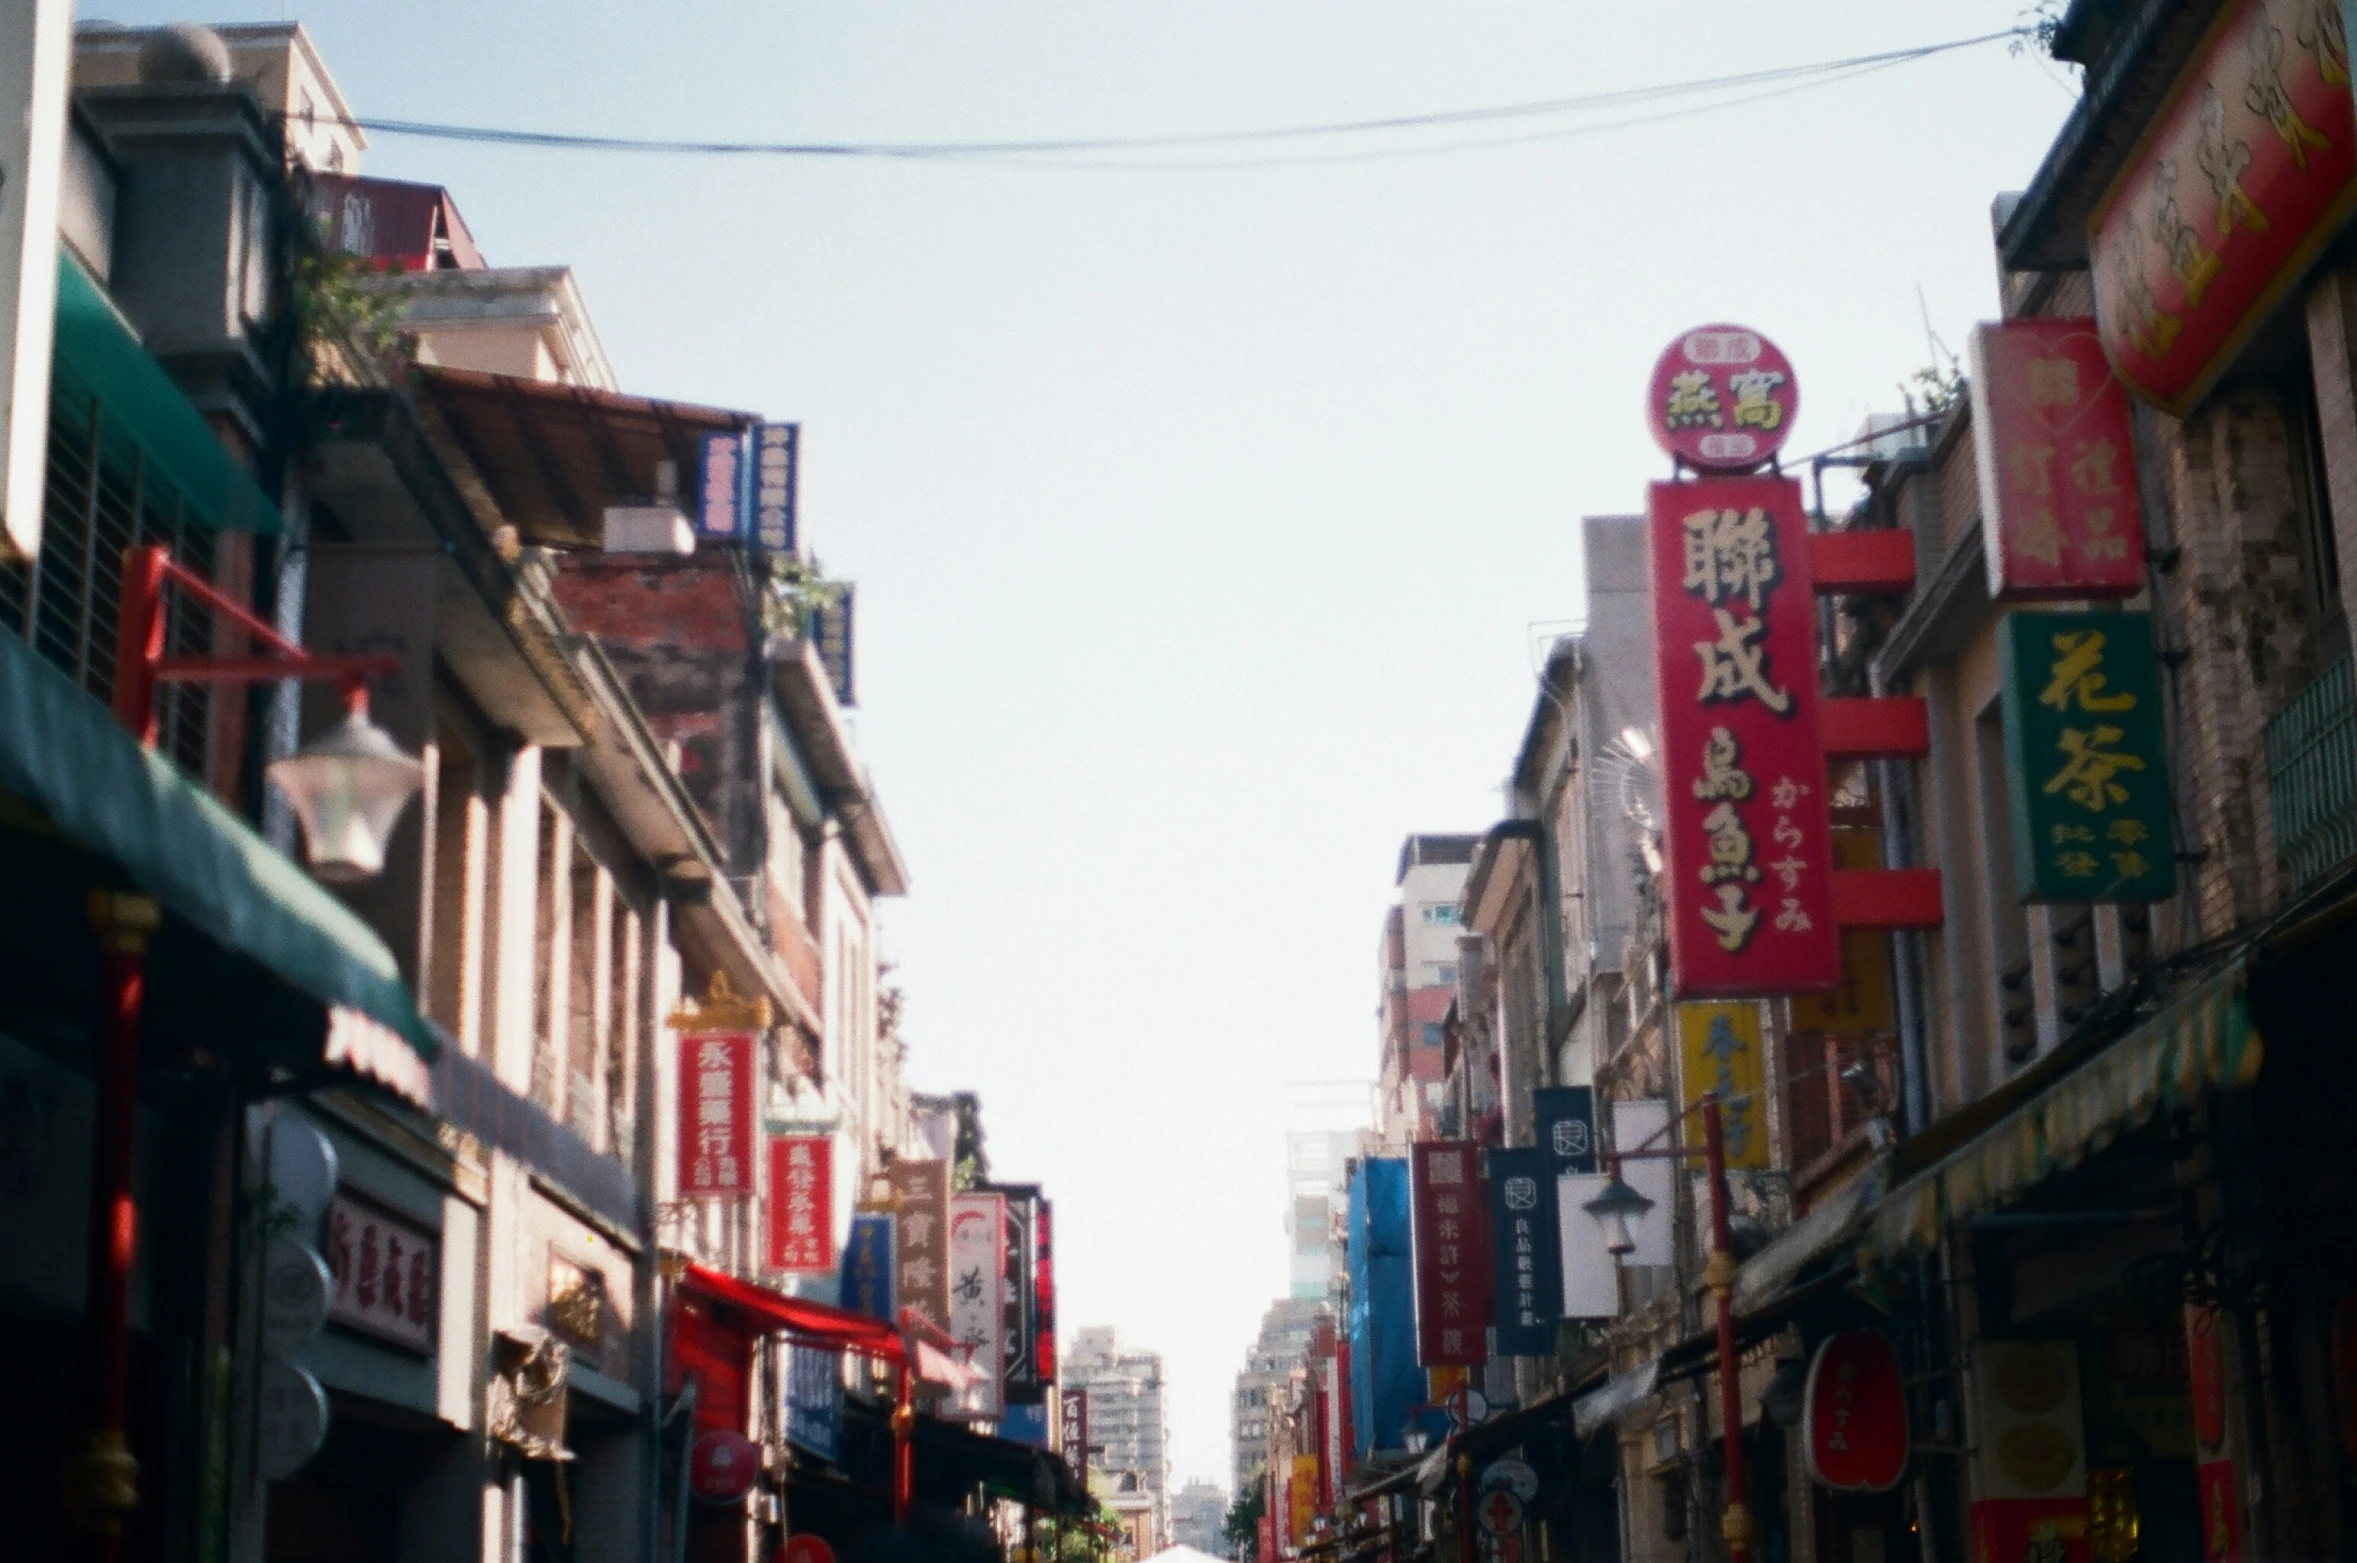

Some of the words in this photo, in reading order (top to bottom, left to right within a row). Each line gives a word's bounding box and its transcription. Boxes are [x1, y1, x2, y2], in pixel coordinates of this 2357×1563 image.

[1667, 368, 1786, 430] 燕窩
[2039, 628, 2149, 813] 花茶
[1768, 774, 1813, 932] からすみ
